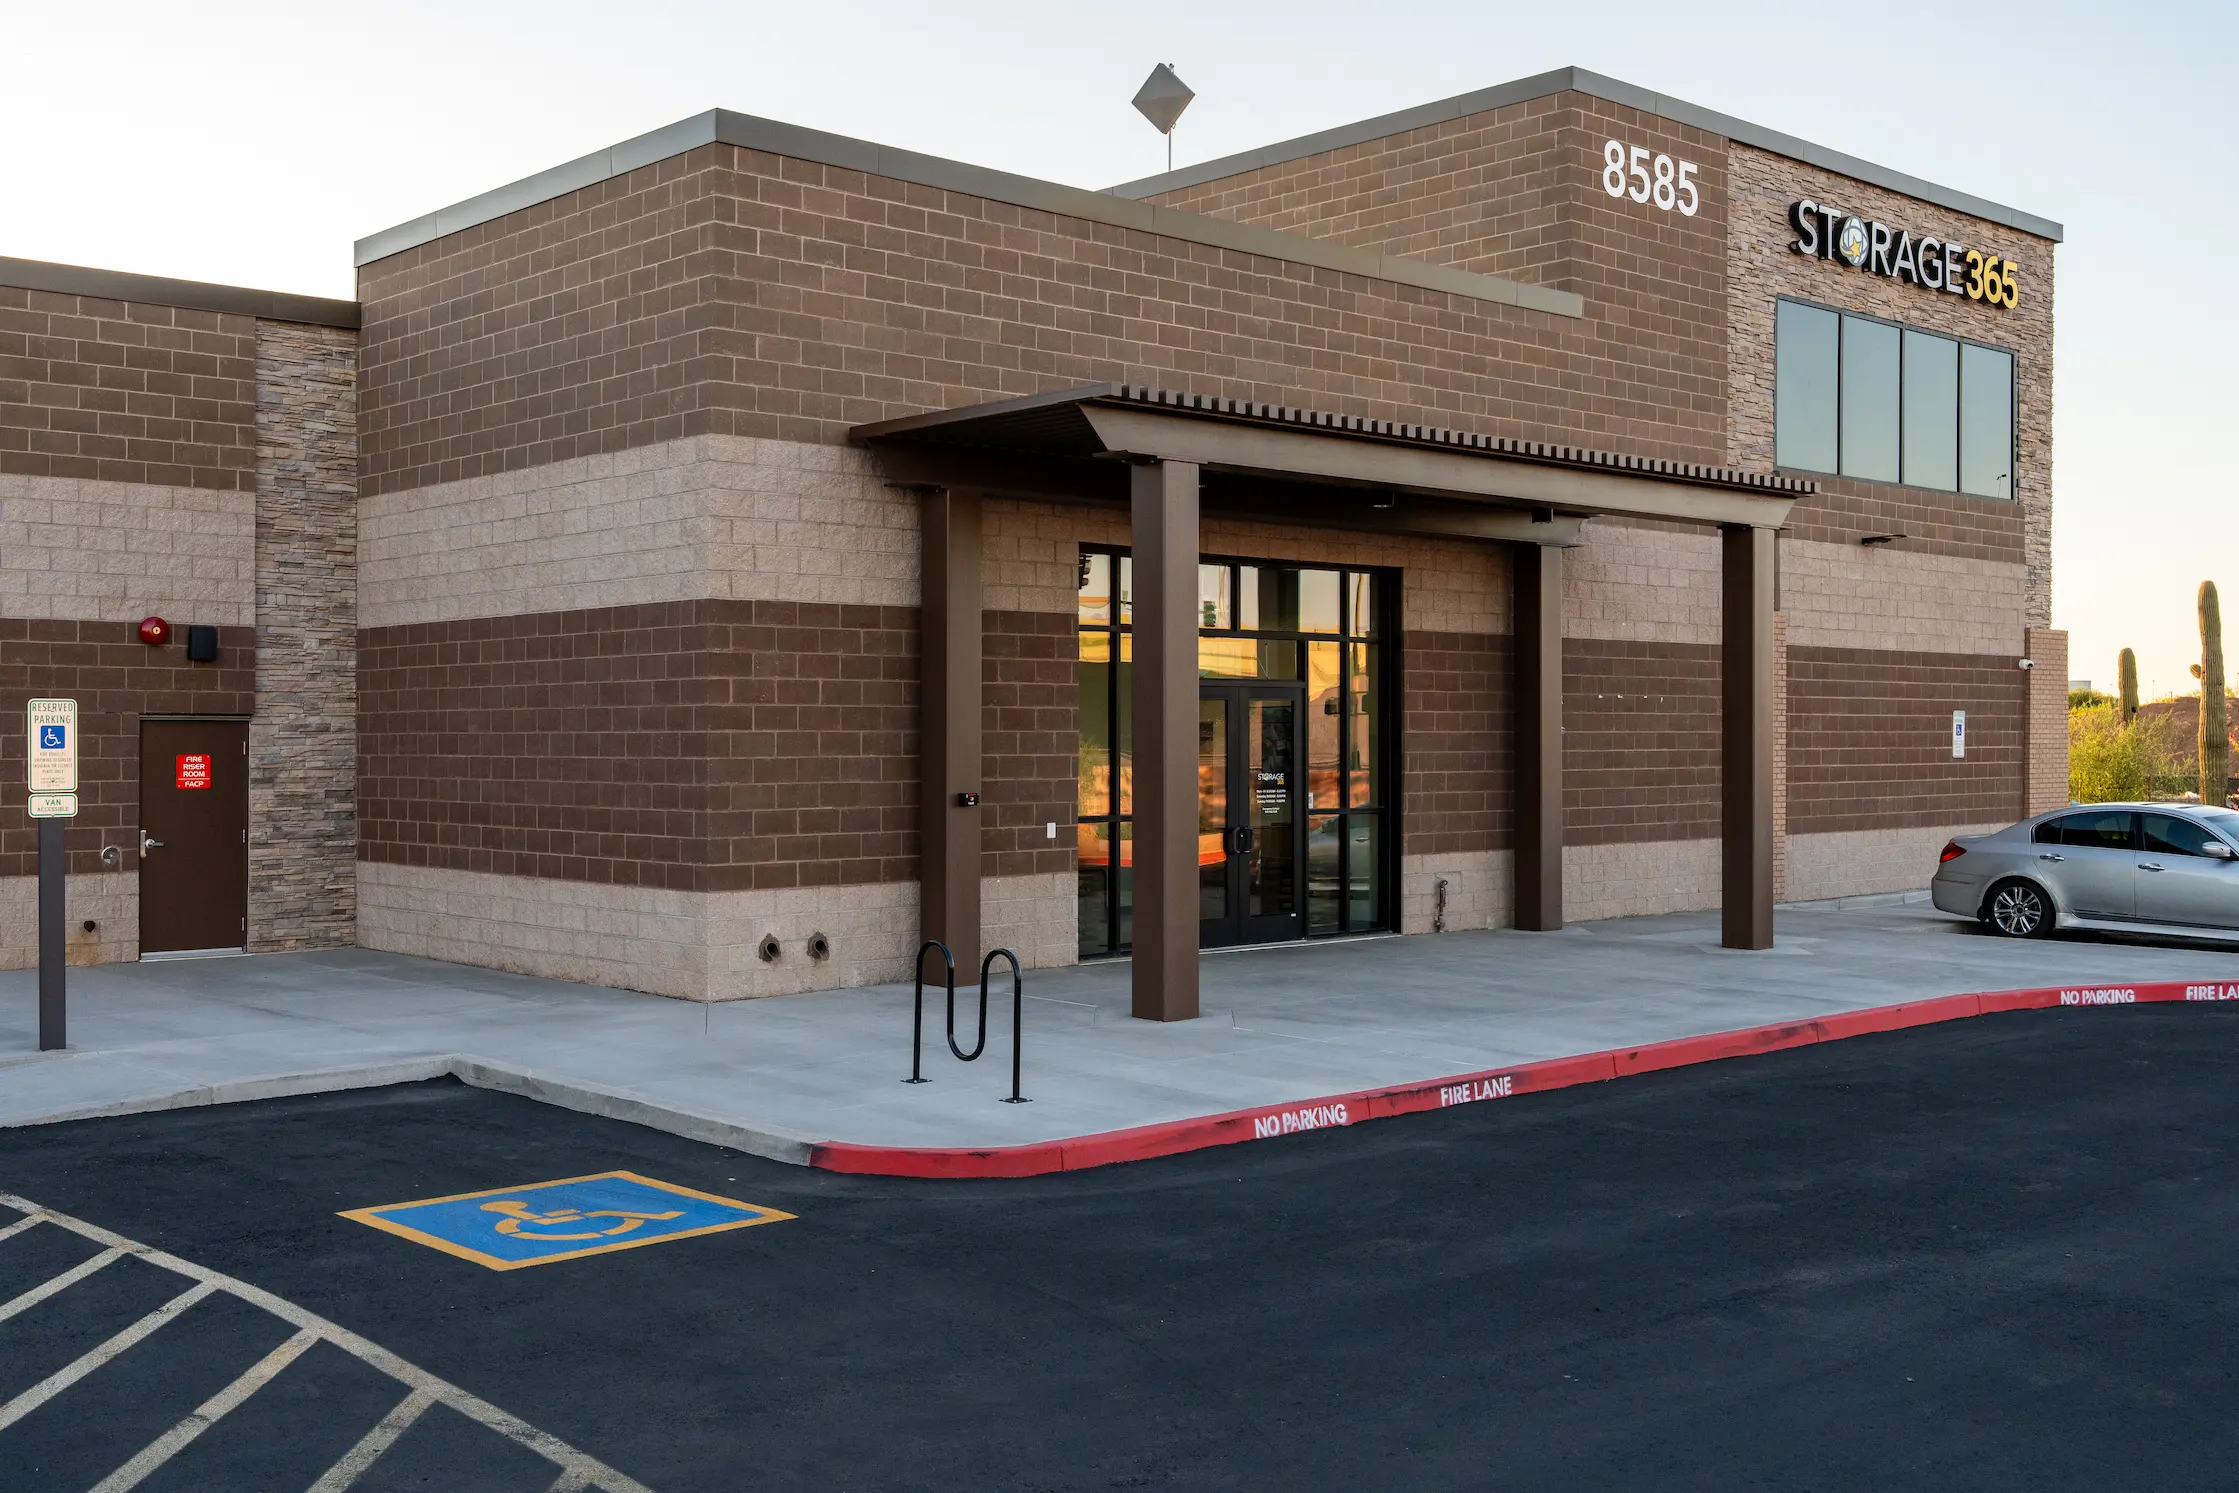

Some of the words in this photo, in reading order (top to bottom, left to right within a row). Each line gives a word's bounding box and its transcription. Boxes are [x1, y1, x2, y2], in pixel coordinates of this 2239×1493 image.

[1602, 139, 1699, 217] 8585
[32, 703, 73, 712] RESERVED
[34, 715, 71, 724] PARKING
[2060, 990, 2080, 1005] NO
[2082, 989, 2136, 1004] PARKING
[2186, 985, 2216, 1001] FIRE
[2218, 984, 2239, 1000] LA
[1440, 1081, 1472, 1107] FIRE
[1473, 1076, 1513, 1101] LANE
[1254, 1115, 1281, 1140] NO
[1282, 1103, 1348, 1134] PARKING
